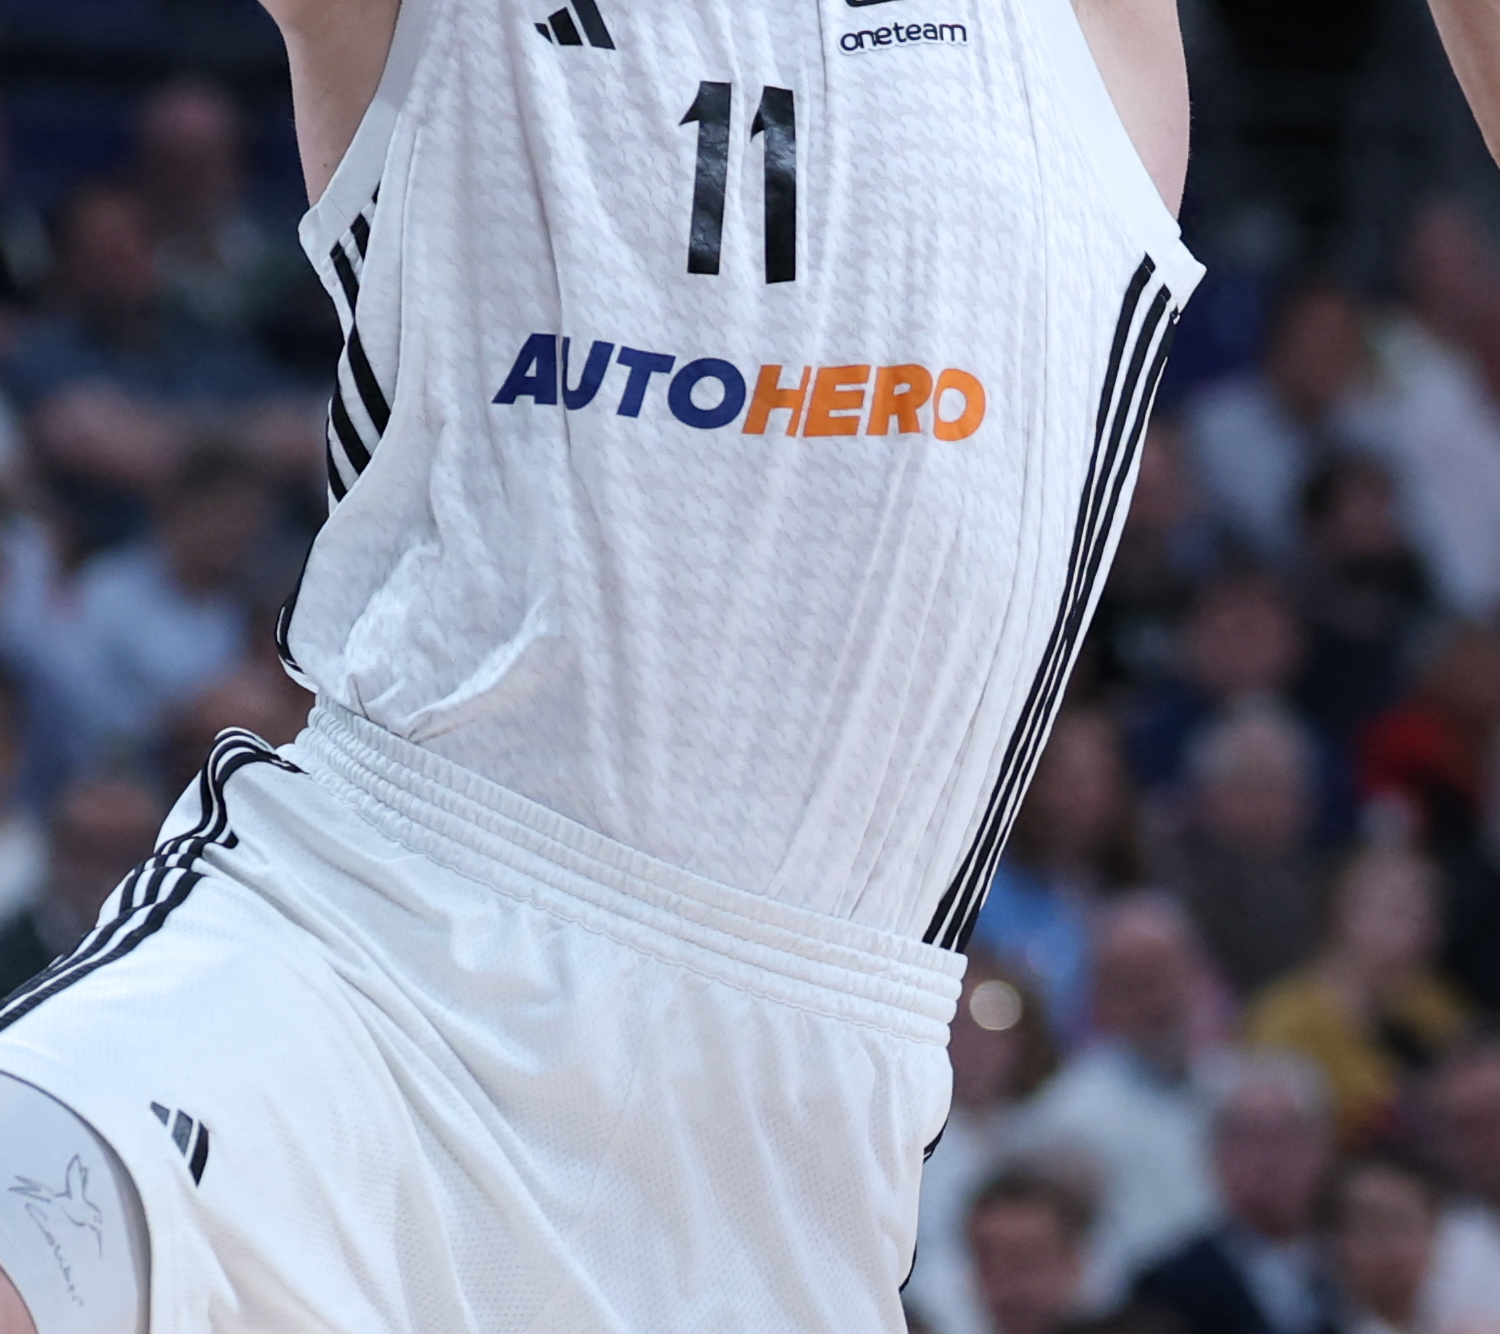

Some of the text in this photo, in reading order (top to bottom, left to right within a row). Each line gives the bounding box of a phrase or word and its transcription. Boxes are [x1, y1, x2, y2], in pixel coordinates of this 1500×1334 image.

[840, 22, 967, 51] oneteam
[678, 80, 797, 284] 11
[491, 332, 986, 441] AUTOHERO
